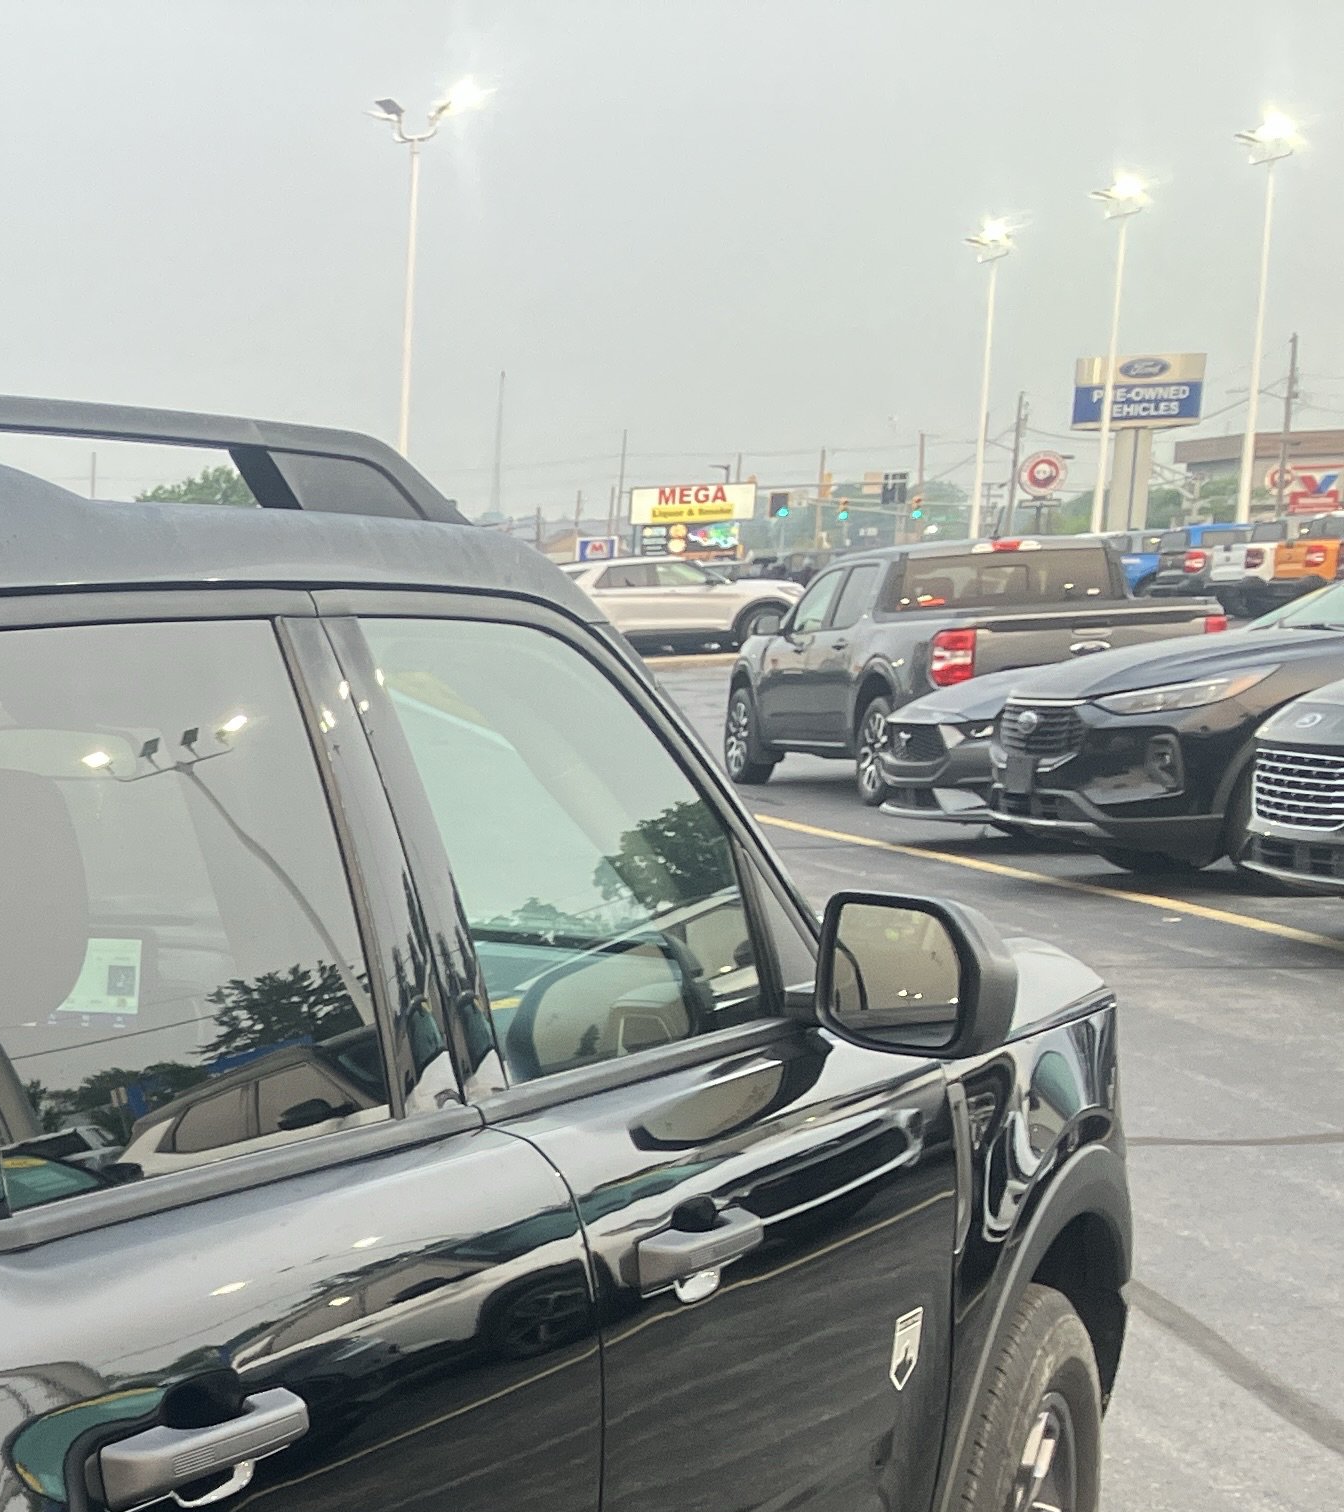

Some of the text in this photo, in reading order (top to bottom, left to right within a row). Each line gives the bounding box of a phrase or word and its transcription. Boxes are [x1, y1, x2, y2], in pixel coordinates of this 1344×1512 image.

[1092, 386, 1190, 404] PE-OWNED
[1110, 402, 1180, 418] EHICLES
[658, 484, 727, 505] MEGA
